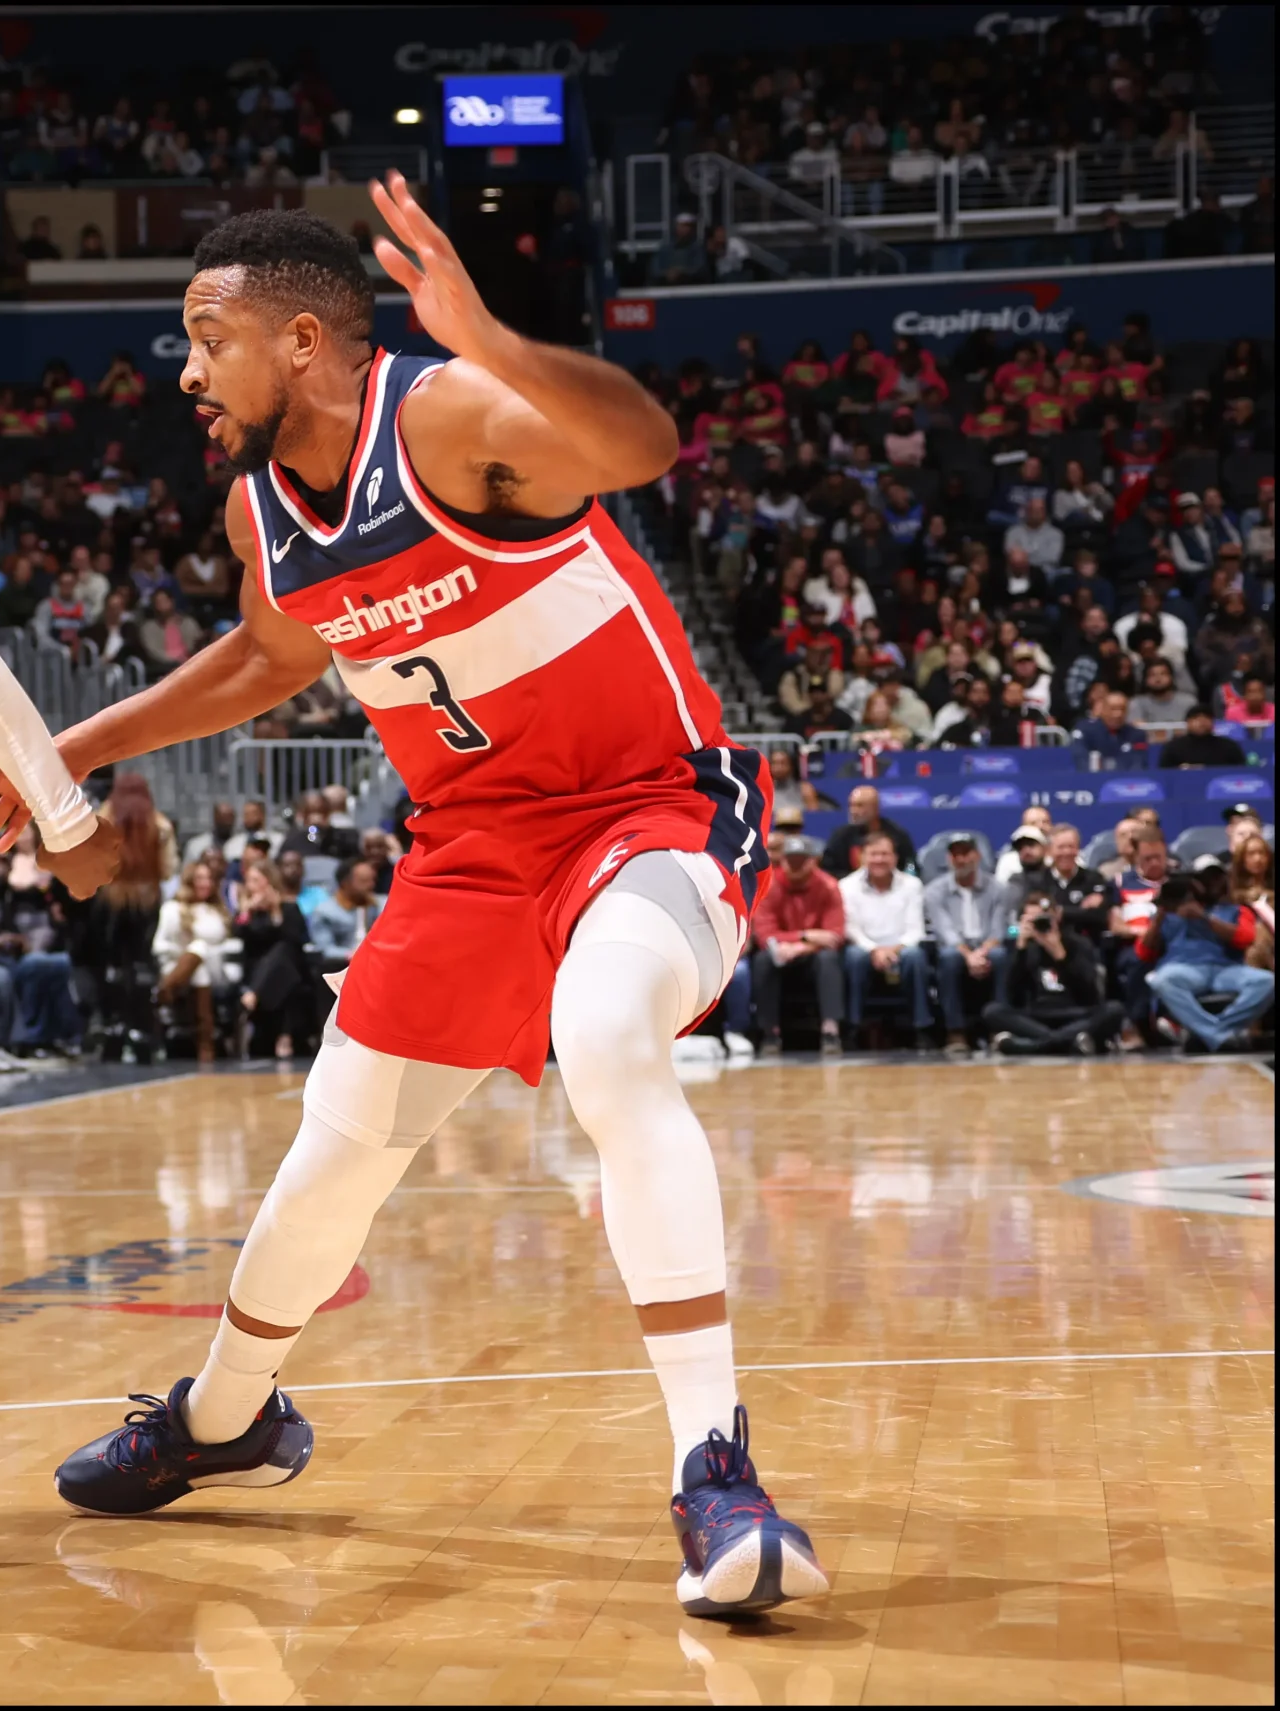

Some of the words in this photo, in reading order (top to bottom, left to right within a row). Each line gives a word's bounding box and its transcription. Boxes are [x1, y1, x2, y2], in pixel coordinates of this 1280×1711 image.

[358, 501, 406, 536] Robinhood
[312, 564, 478, 645] ashington
[391, 655, 492, 754] 3
